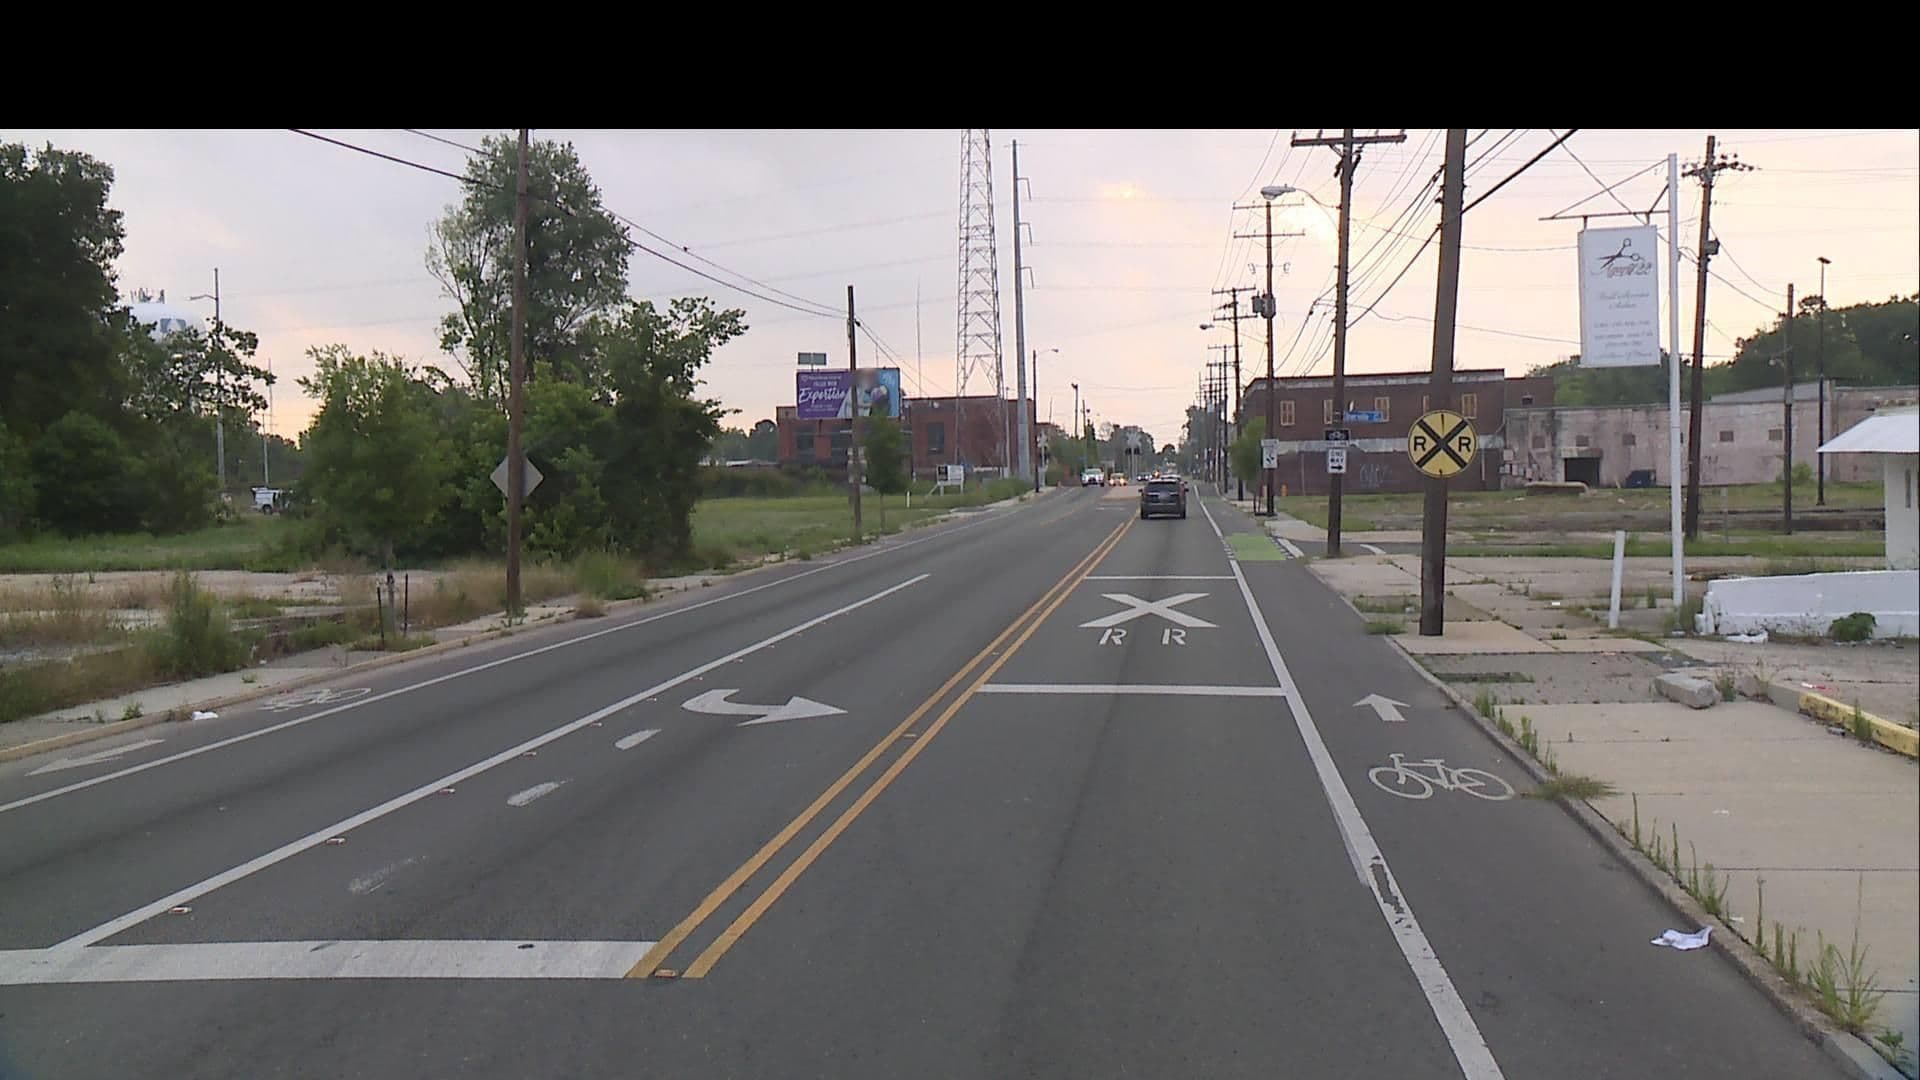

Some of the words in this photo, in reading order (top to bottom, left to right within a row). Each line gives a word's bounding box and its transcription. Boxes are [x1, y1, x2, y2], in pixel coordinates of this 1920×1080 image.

[799, 387, 845, 405] Expertise
[1414, 436, 1426, 452] R
[1458, 436, 1471, 452] R
[1099, 628, 1127, 645] R
[1162, 628, 1186, 645] R
